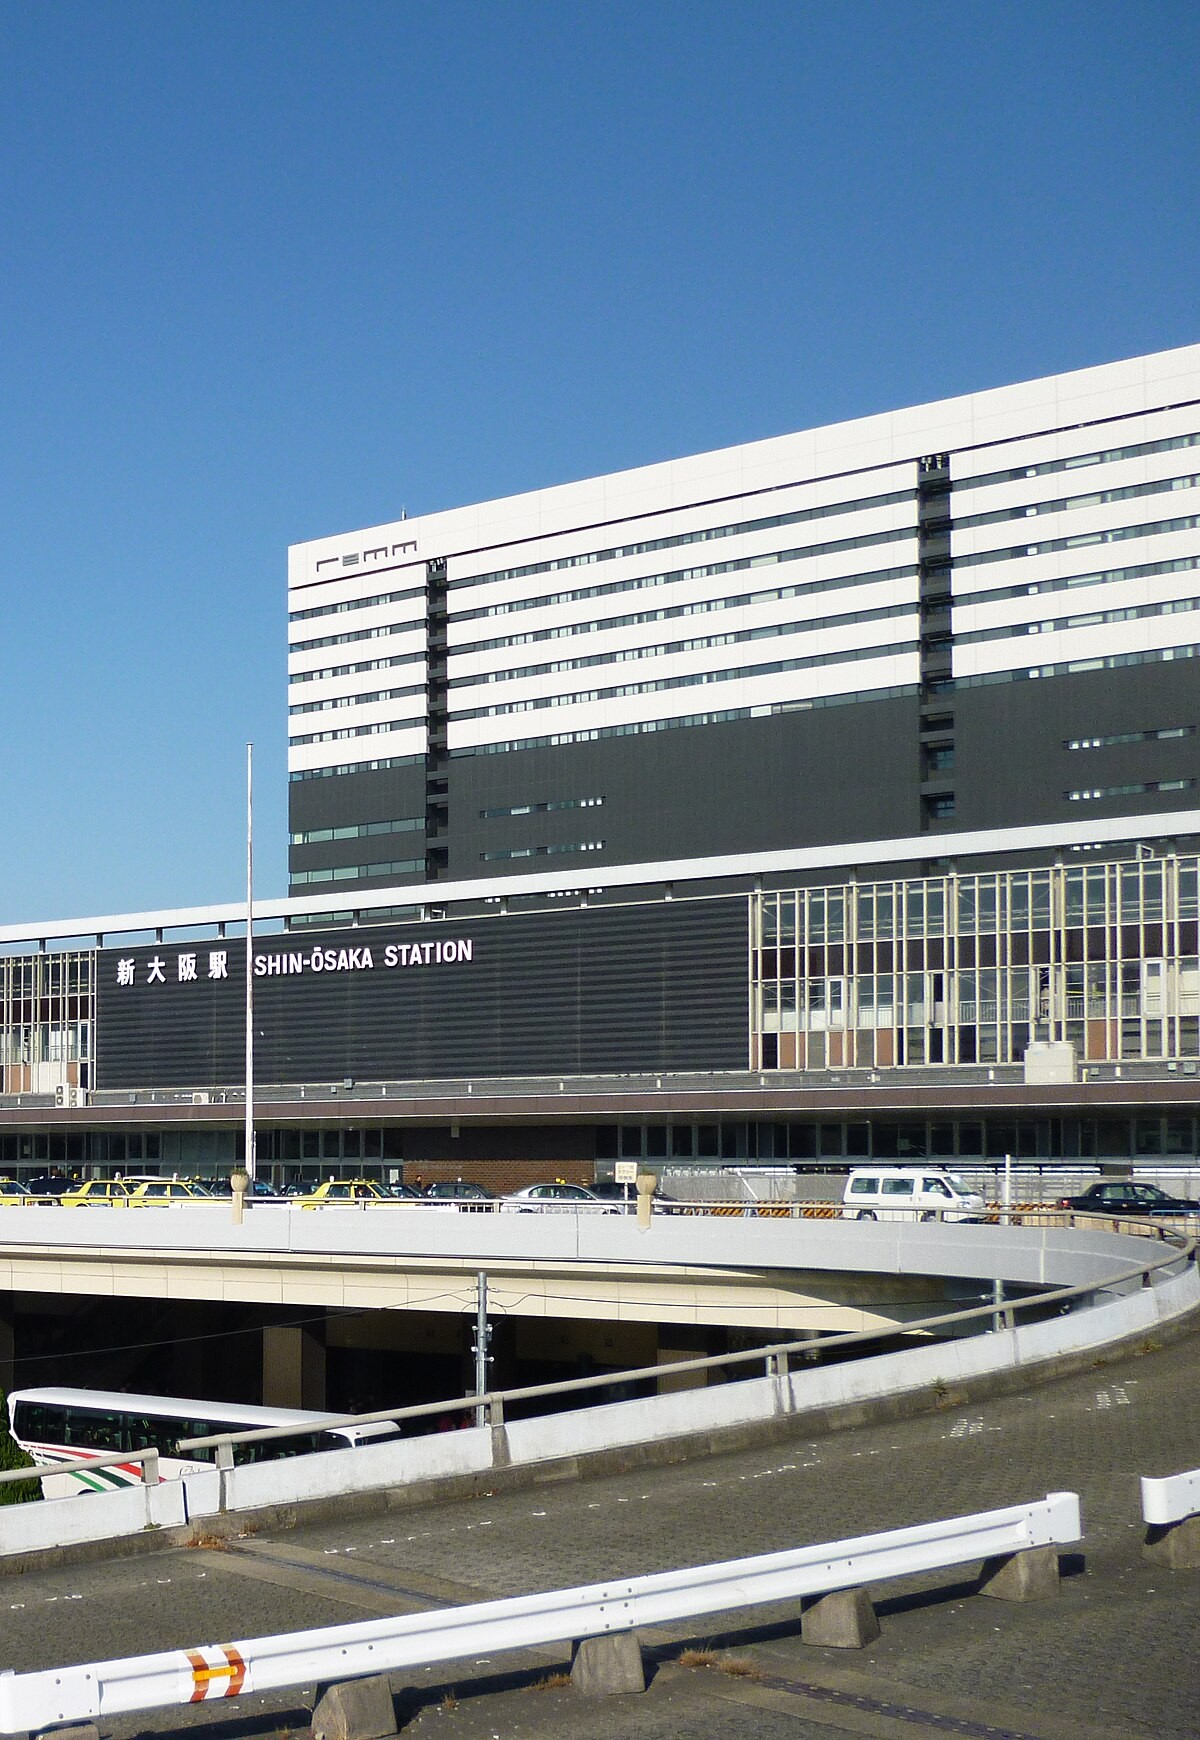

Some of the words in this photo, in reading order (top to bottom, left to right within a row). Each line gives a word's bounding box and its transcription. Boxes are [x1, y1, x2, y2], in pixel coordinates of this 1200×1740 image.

[316, 540, 417, 573] remm
[116, 950, 228, 985] 新大阪駅
[253, 946, 374, 977] SHIN-ŌSAKA
[383, 939, 474, 967] STATION
